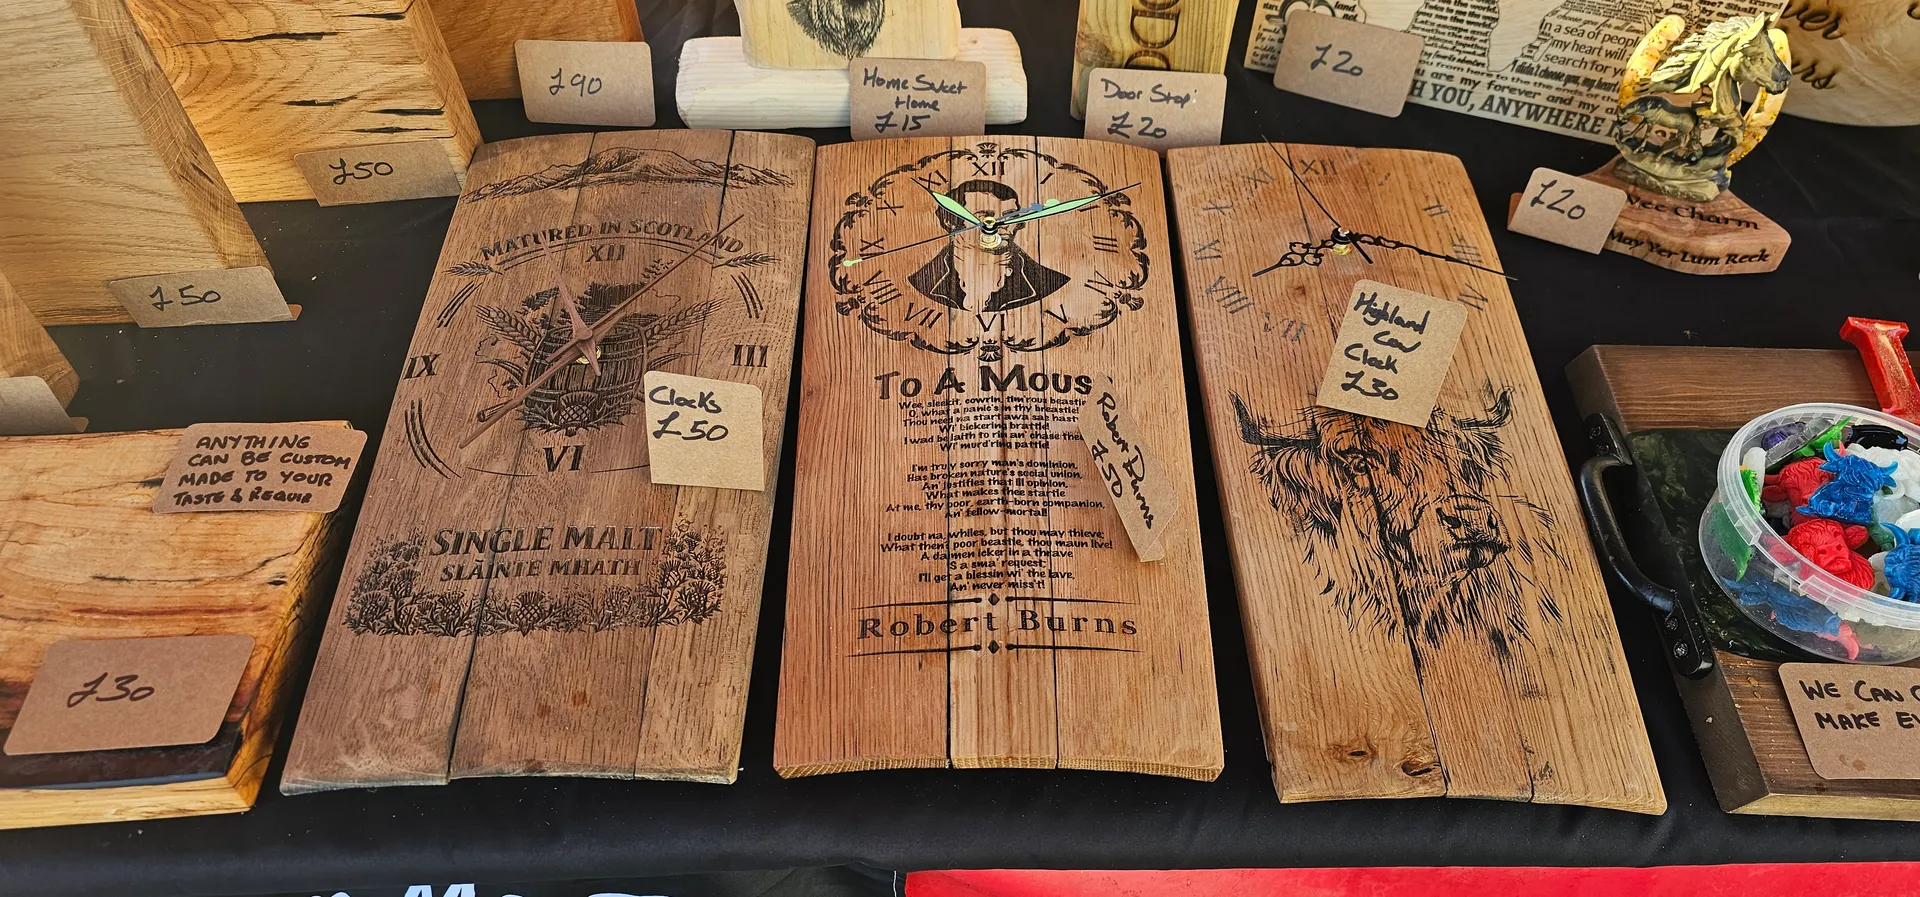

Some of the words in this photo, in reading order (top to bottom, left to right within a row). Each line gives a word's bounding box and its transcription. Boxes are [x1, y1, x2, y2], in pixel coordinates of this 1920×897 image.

[1554, 24, 1562, 33] a
[1564, 26, 1584, 38] sea
[1587, 30, 1602, 40] of
[1310, 44, 1364, 77] £20
[1551, 39, 1569, 52] my
[1572, 40, 1604, 56] heart
[1605, 49, 1627, 60] will
[1544, 54, 1588, 69] search
[1589, 60, 1611, 74] for
[550, 68, 603, 97] £90
[863, 66, 910, 90] Home
[1436, 62, 1464, 71] from
[1466, 67, 1493, 77] here
[1512, 76, 1530, 85] the
[1533, 82, 1553, 90] the
[1555, 87, 1583, 96] ends
[1102, 78, 1143, 101] Door
[1430, 72, 1454, 82] are
[1460, 76, 1481, 89] my
[1487, 80, 1541, 99] forever
[1546, 94, 1574, 106] and
[1578, 101, 1600, 114] my
[895, 94, 941, 112] Home
[1429, 83, 1474, 112] YOU,
[1478, 94, 1606, 135] ANYWHERE
[875, 111, 931, 133] £15
[1109, 112, 1167, 138] £20
[329, 158, 393, 185] £50
[1530, 180, 1586, 220] £20
[1674, 206, 1760, 230] Charm
[480, 224, 593, 261] MATURED
[600, 221, 621, 235] IN
[628, 220, 744, 253] SCOTLAND
[1608, 229, 1644, 250] May
[1648, 240, 1678, 258] Yer
[1680, 251, 1721, 266] Lum
[1725, 248, 1770, 265] Reek
[149, 286, 221, 311] £50
[1354, 292, 1431, 335] Highland
[1373, 331, 1421, 353] Cow
[1344, 343, 1399, 375] Clock
[874, 371, 923, 400] To
[934, 367, 966, 395] A
[979, 364, 1093, 395] Mous
[1341, 370, 1399, 401] £30
[649, 386, 721, 414] Clocks
[964, 404, 999, 414] panic's
[1014, 405, 1032, 413] thy
[652, 412, 729, 442] £50
[904, 419, 927, 427] Thou
[960, 422, 1007, 432] bickering
[196, 435, 311, 450] ANYTHING
[910, 436, 934, 444] wad
[951, 432, 976, 441] laith
[1030, 431, 1060, 440] chase
[188, 454, 229, 467] CAN
[241, 451, 272, 466] BE
[280, 453, 351, 470] CUSTOM
[960, 460, 988, 469] sorry
[992, 459, 1024, 467] man's
[1027, 460, 1078, 469] dominion,
[178, 470, 233, 487] MADE
[246, 470, 267, 484] TO
[280, 470, 333, 487] YOUR
[907, 474, 927, 482] Has
[930, 471, 968, 480] broken
[970, 468, 1015, 477] nature's
[1051, 470, 1083, 479] union,
[988, 478, 1013, 486] that
[1027, 480, 1068, 489] opinion,
[173, 491, 225, 507] TASTE
[962, 488, 998, 497] makes
[1002, 487, 1025, 496] thee
[1028, 488, 1065, 497] startle
[926, 501, 944, 510] thy
[976, 497, 1039, 506] earth-born
[1042, 500, 1105, 509] companion,
[428, 526, 554, 557] SINGLE
[562, 524, 663, 552] MALT
[880, 543, 916, 552] What
[954, 540, 977, 550] poor
[981, 538, 1024, 547] beastie,
[1056, 540, 1088, 548] maun
[894, 532, 926, 541] doubt
[1011, 528, 1036, 536] thou
[1040, 529, 1065, 538] may
[1033, 548, 1073, 557] thrave
[549, 558, 642, 578] MHATH
[966, 570, 1003, 579] blessin
[972, 581, 1005, 590] never
[857, 612, 999, 640] Robert
[1018, 610, 1138, 635] Burns
[68, 672, 155, 708] £30
[1799, 680, 1841, 700] WE
[1854, 680, 1904, 702] CAN
[1814, 712, 1880, 730] MAKE
